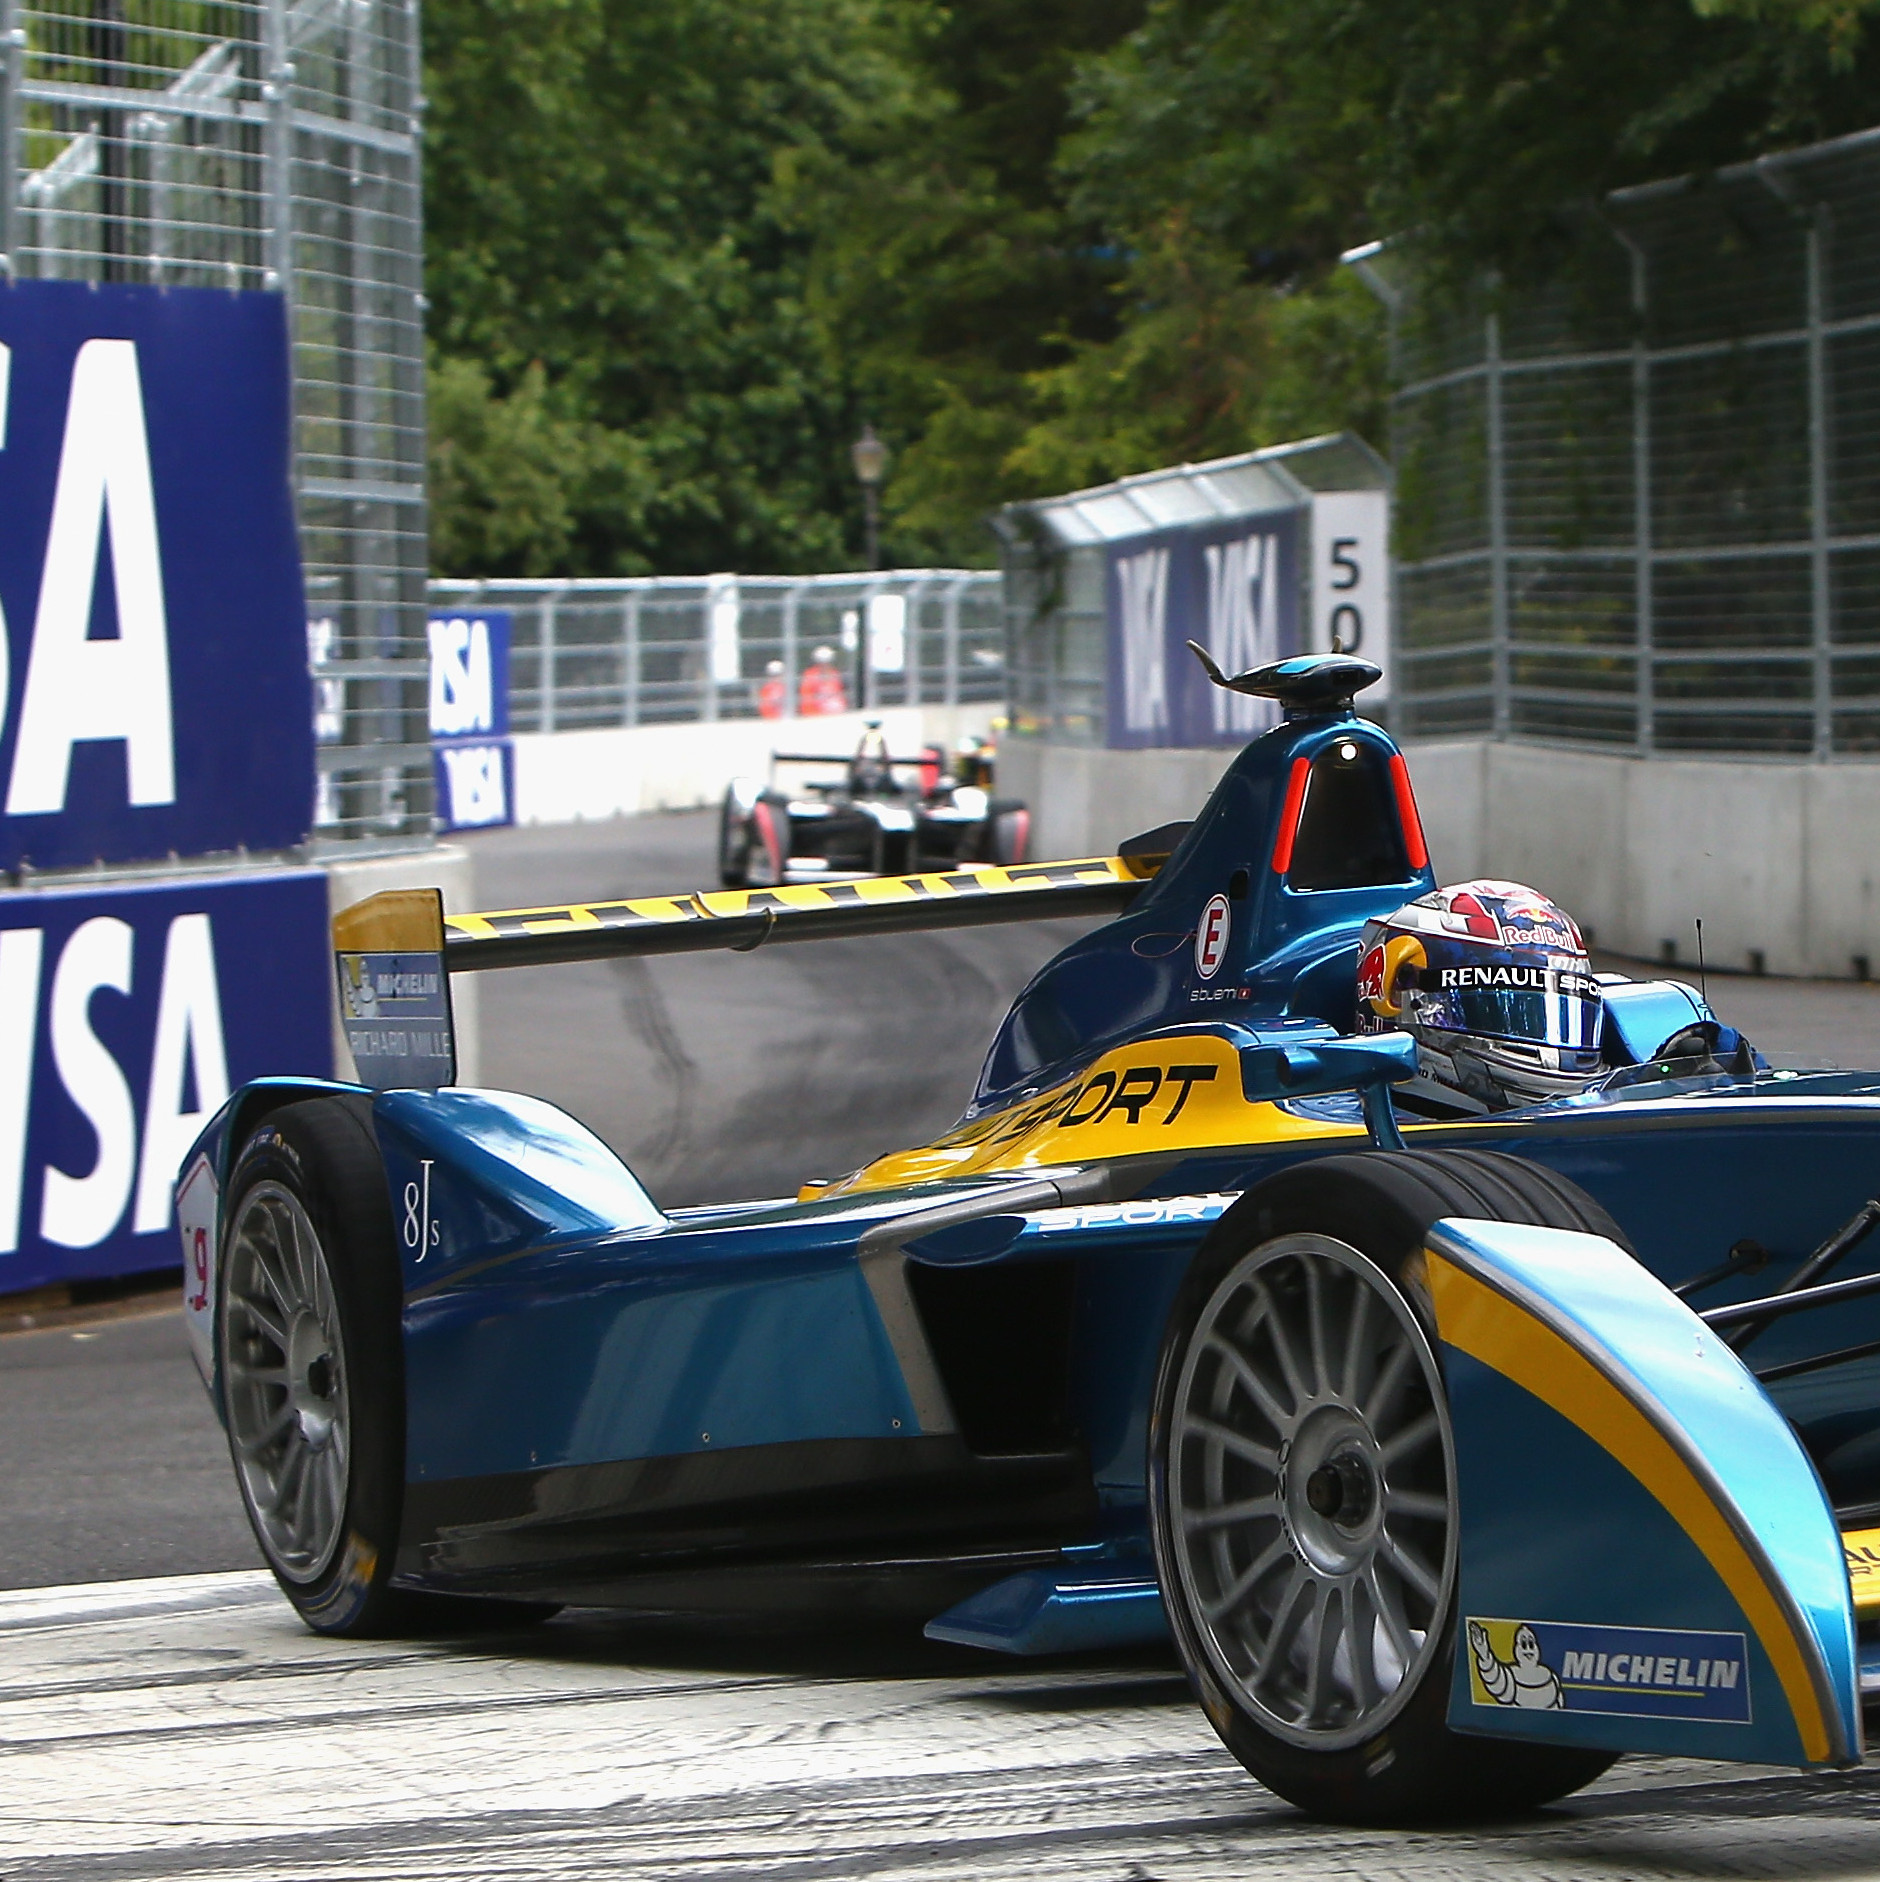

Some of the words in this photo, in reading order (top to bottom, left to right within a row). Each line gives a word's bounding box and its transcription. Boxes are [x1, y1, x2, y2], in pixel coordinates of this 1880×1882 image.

[1202, 909, 1224, 965] E
[1502, 924, 1545, 945] Red
[1542, 925, 1574, 953] Bull
[1440, 966, 1557, 994] RENAULT
[1559, 974, 1602, 998] SPO
[1561, 1650, 1740, 1689] MICHELIN
